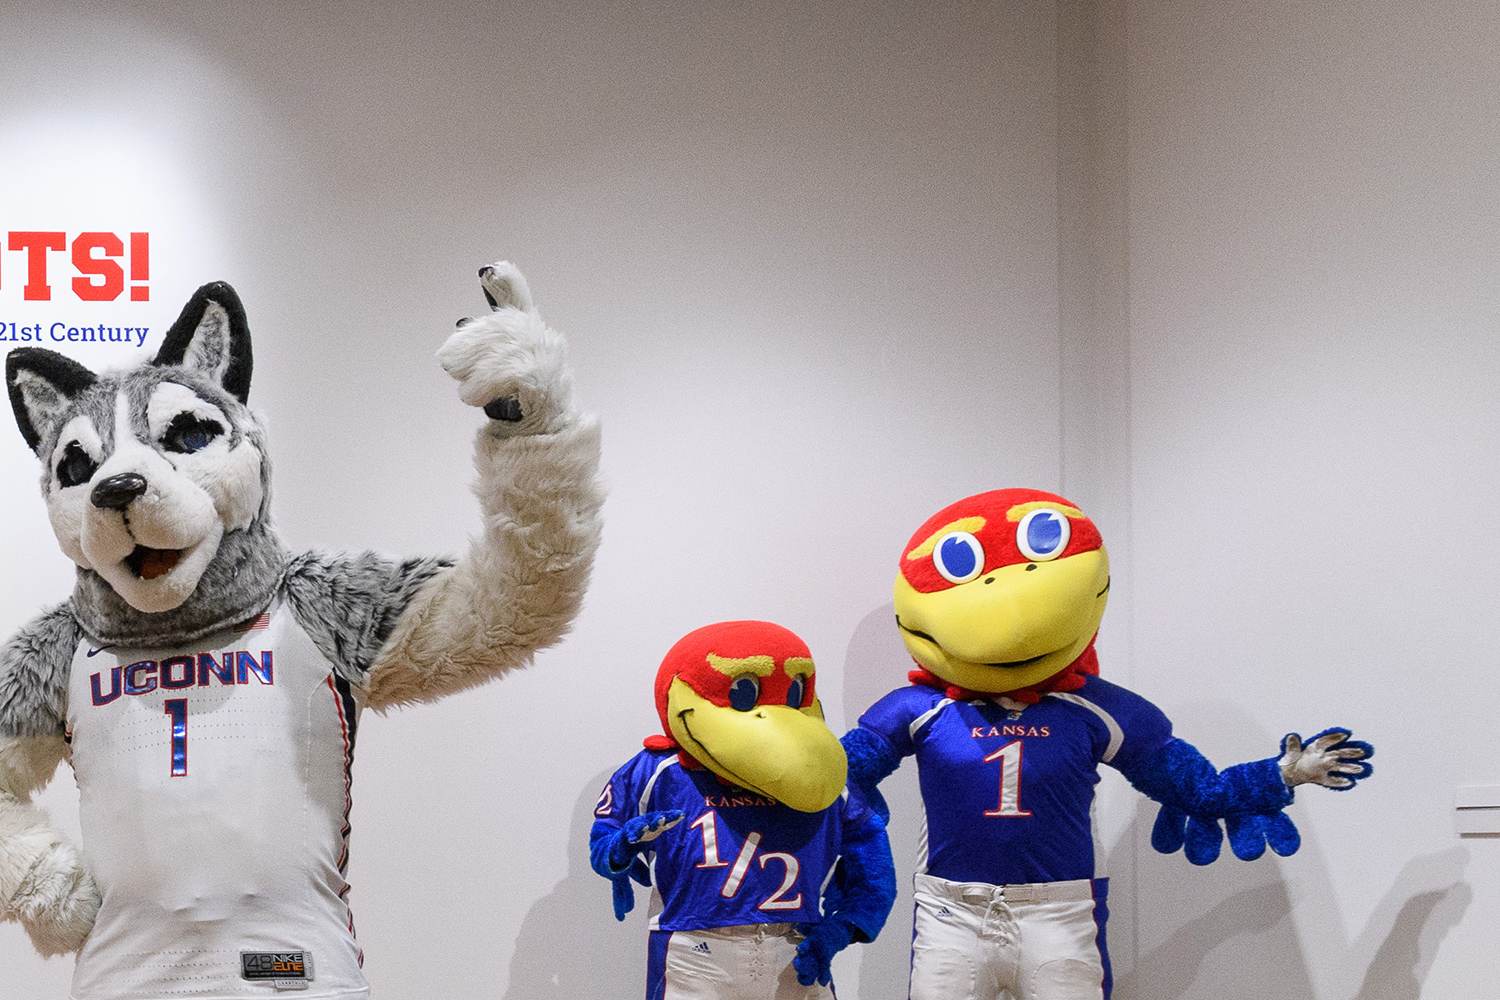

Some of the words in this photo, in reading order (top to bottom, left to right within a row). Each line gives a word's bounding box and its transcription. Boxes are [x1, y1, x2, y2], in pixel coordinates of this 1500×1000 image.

[49, 321, 150, 347] Century
[90, 650, 274, 706] UCONN
[164, 698, 188, 777] 1
[971, 725, 1051, 738] KANSAS
[983, 738, 1033, 818] 1
[704, 795, 777, 808] KANSAS
[689, 809, 803, 911] 1/2
[247, 955, 272, 970] 48
[273, 953, 303, 963] NIKE
